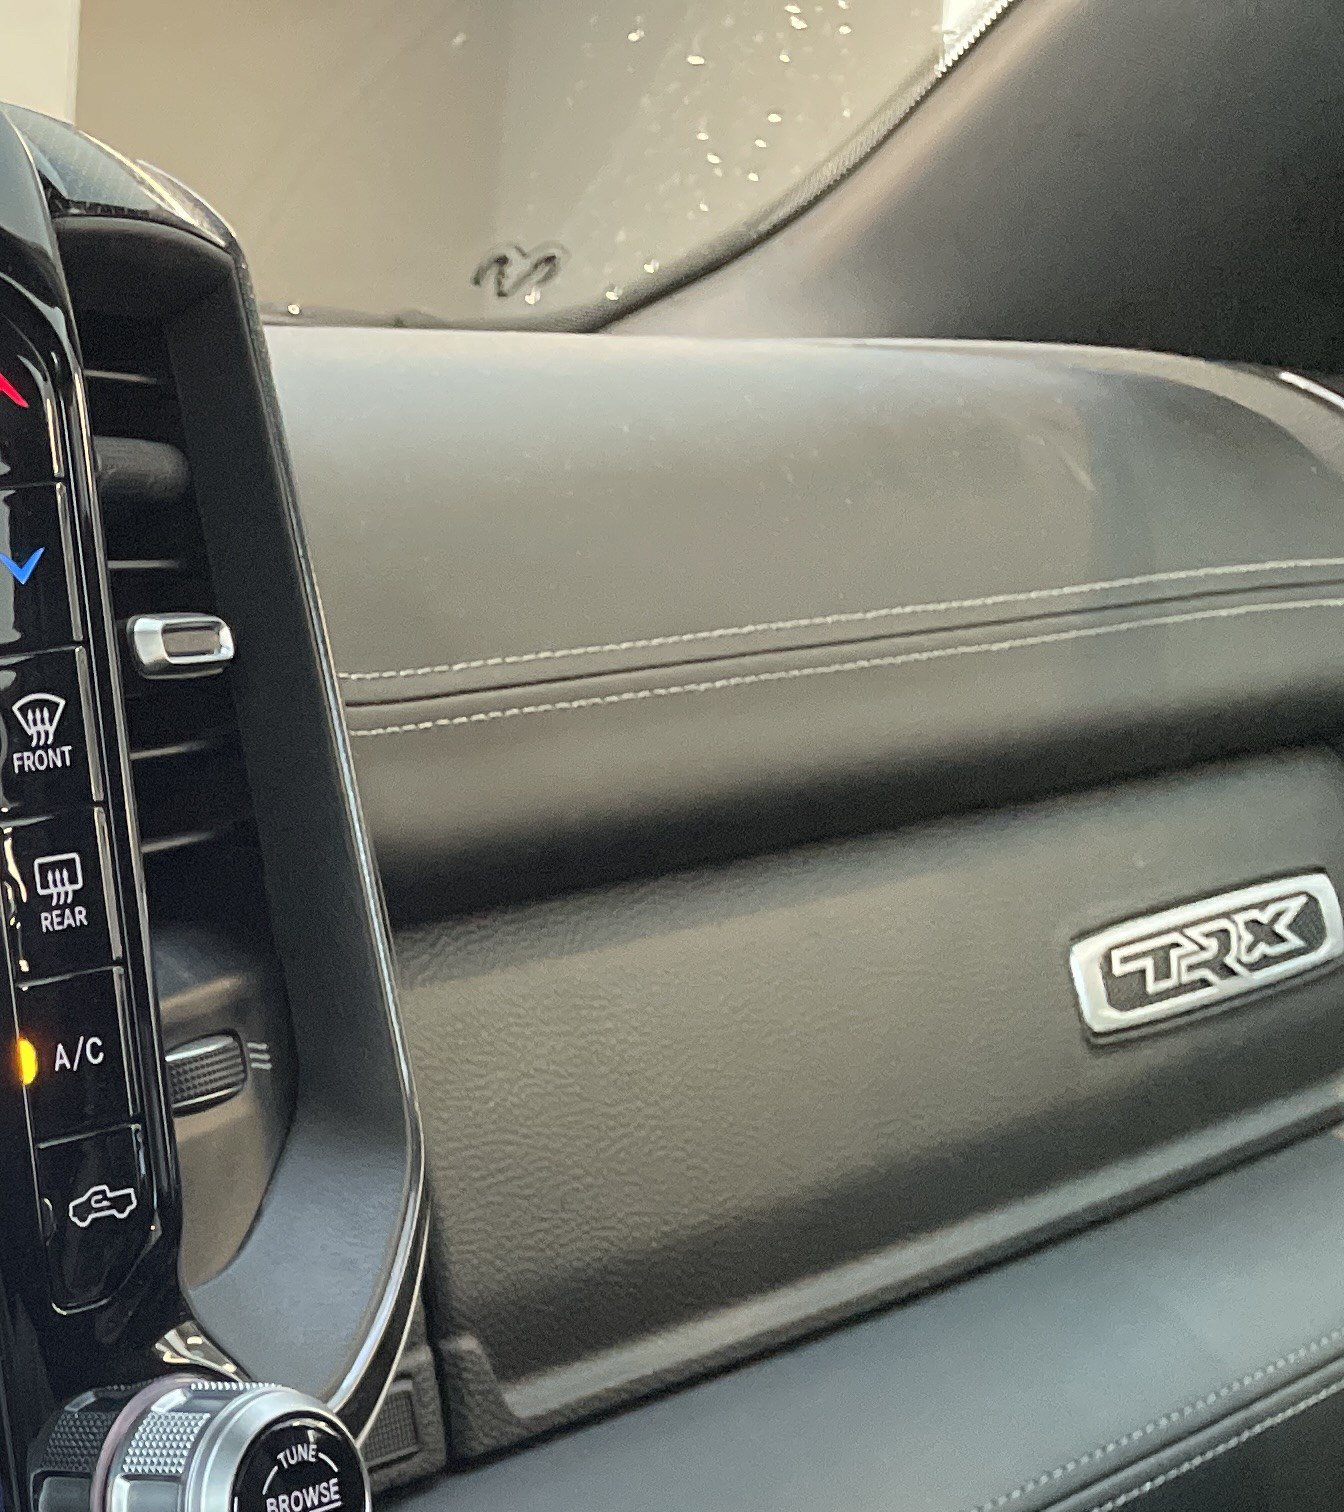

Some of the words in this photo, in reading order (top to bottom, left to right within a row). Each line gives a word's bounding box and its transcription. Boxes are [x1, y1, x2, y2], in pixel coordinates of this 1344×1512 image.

[12, 746, 72, 774] FRONT
[40, 906, 88, 933] REAR
[1110, 893, 1309, 994] TRX
[54, 1038, 104, 1072] A/C
[276, 1443, 318, 1469] TUNE
